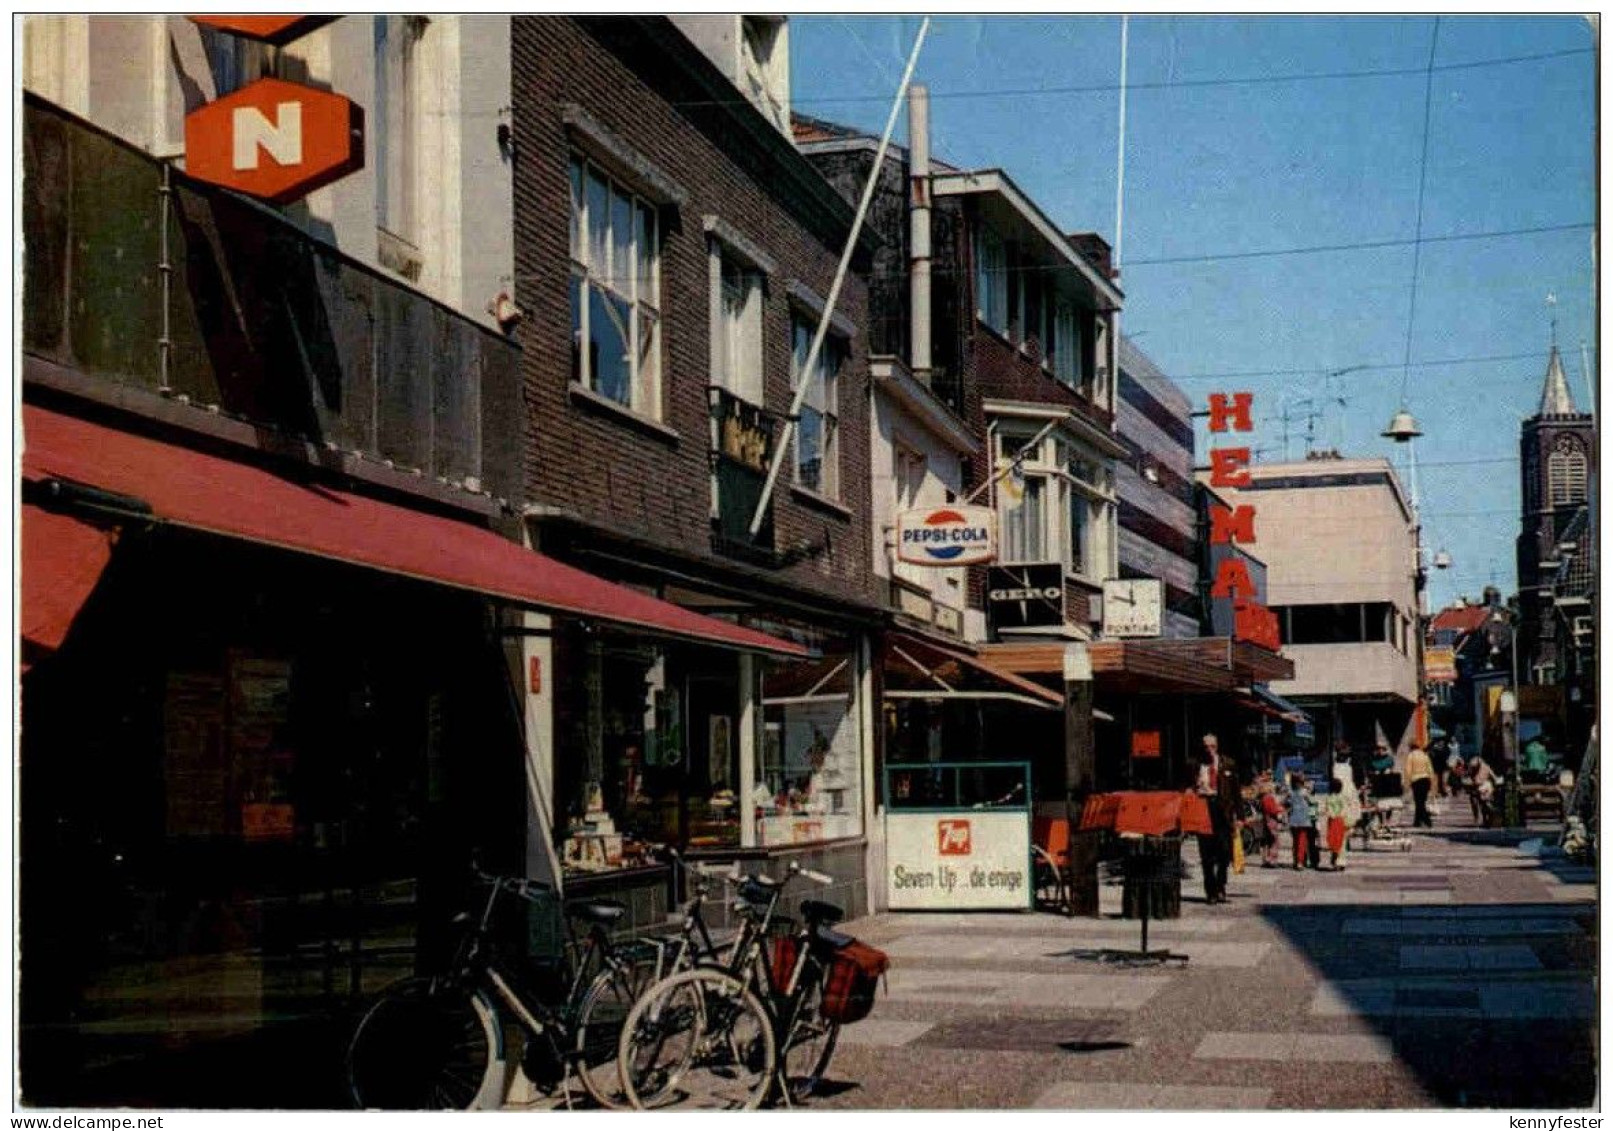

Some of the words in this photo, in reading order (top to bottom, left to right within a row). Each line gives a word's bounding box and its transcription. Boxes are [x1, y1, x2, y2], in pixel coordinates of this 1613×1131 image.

[233, 101, 302, 170] N
[1208, 392, 1257, 599] HEMA
[894, 864, 933, 889] Seven
[938, 865, 957, 893] Up
[988, 866, 1022, 892] enige
